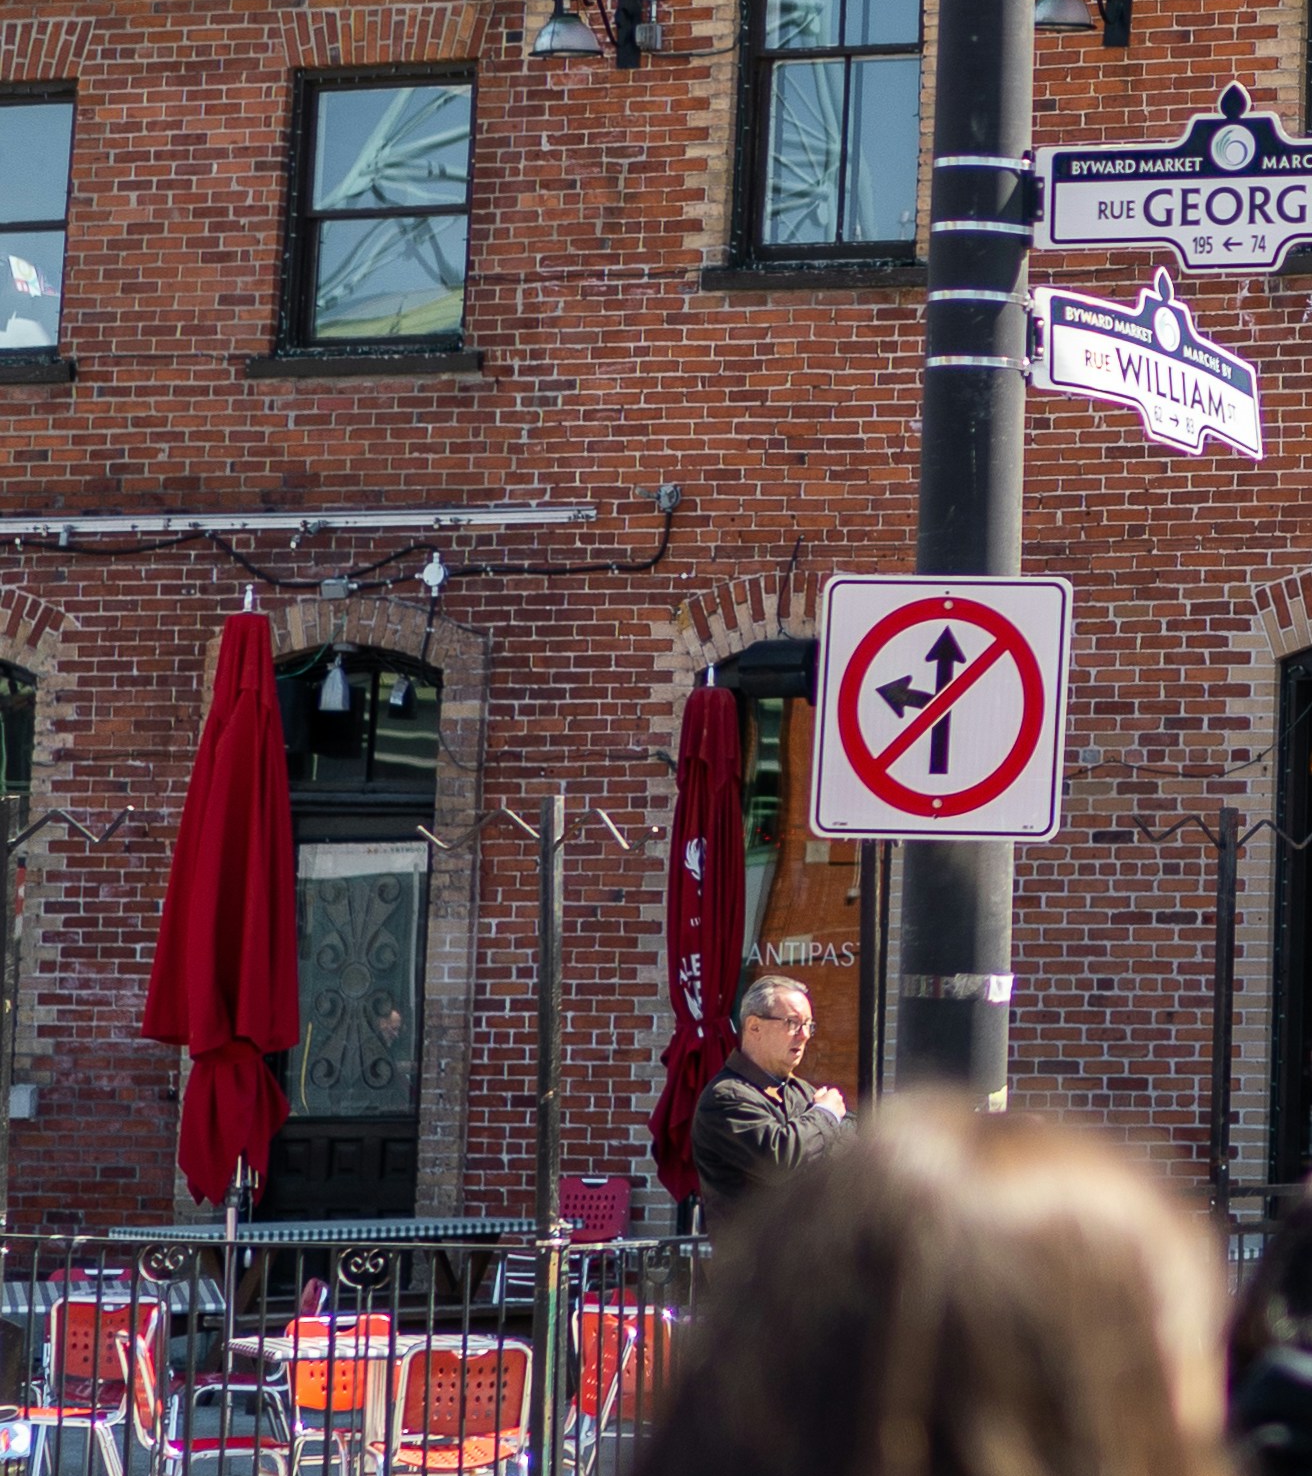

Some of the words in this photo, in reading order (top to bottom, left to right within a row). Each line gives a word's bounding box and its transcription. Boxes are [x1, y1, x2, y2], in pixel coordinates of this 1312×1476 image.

[1071, 159, 1136, 175] BYWARD
[1139, 157, 1203, 173] MARKET
[1098, 201, 1136, 220] RUE
[1193, 236, 1213, 254] 195
[1251, 235, 1267, 253] 74
[1065, 306, 1113, 330] BYWARD
[1114, 319, 1153, 344] MARKET
[1183, 345, 1220, 373] MARCHÉ
[1222, 362, 1232, 380] BY
[1084, 349, 1111, 372] RUE
[1115, 347, 1226, 424] WILLIAM
[746, 942, 860, 967] ANTIPAS
